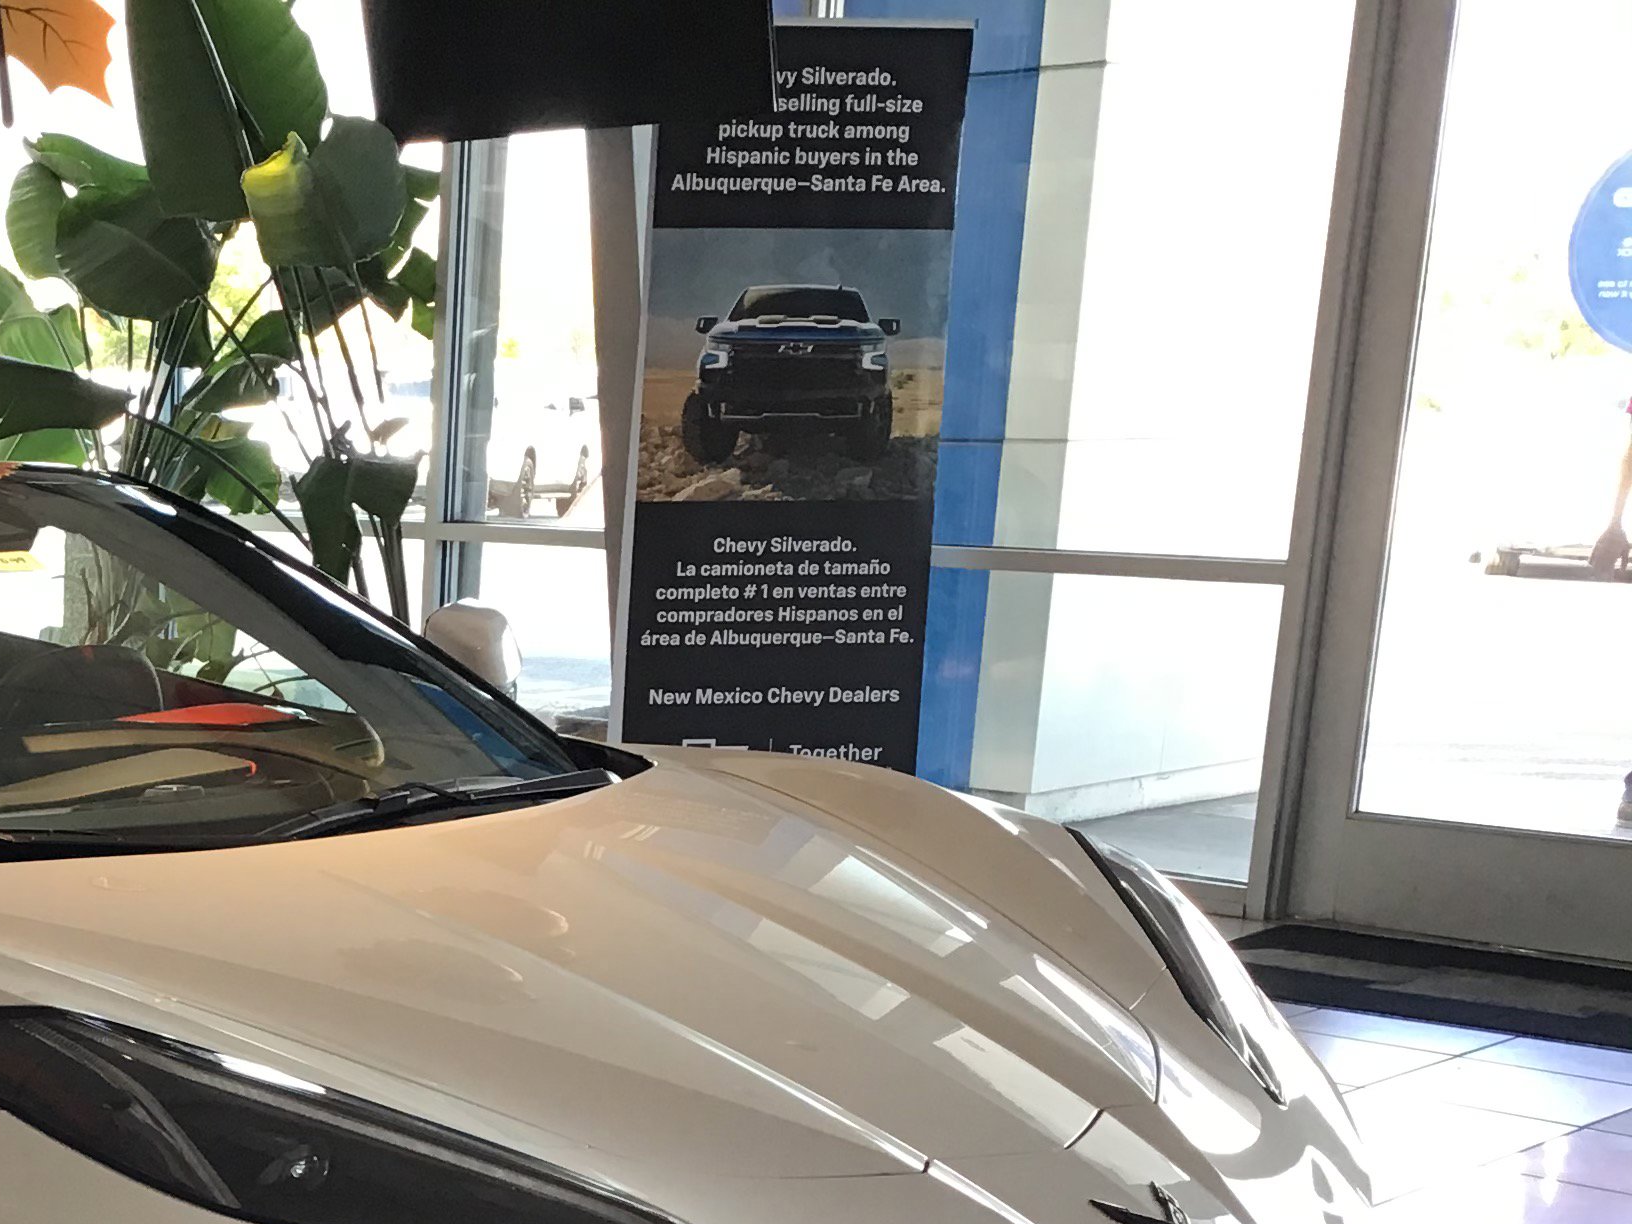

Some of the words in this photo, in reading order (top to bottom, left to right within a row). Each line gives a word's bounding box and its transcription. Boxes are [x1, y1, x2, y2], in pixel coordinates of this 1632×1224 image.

[802, 67, 896, 86] Silverado.
[778, 94, 840, 115] selling
[845, 94, 923, 112] full-size
[719, 120, 783, 141] pickup
[788, 121, 839, 138] truck
[844, 126, 909, 143] among
[707, 146, 790, 167] Hispanic
[795, 147, 860, 168] buyers
[865, 147, 881, 165] in
[887, 148, 918, 165] the
[872, 175, 893, 191] Fe
[897, 176, 945, 192] Area.
[714, 537, 767, 556] Chevy
[771, 536, 856, 552] Silverado.
[677, 562, 696, 576] La
[701, 560, 793, 576] camioneta
[798, 560, 819, 575] de
[824, 559, 890, 575] tamaño
[656, 584, 739, 602] completo
[773, 587, 793, 598] en
[798, 584, 856, 598] ventas
[861, 583, 906, 597] entre
[657, 607, 773, 625] compradores
[778, 606, 858, 624] Hispanos
[863, 609, 883, 620] en
[888, 605, 902, 620] el
[641, 630, 680, 645] área
[685, 630, 706, 645] de
[890, 629, 914, 643] Fe.
[649, 689, 691, 704] New
[696, 687, 763, 704] Mexico
[768, 687, 824, 706] Chevy
[829, 686, 899, 702] Dealers
